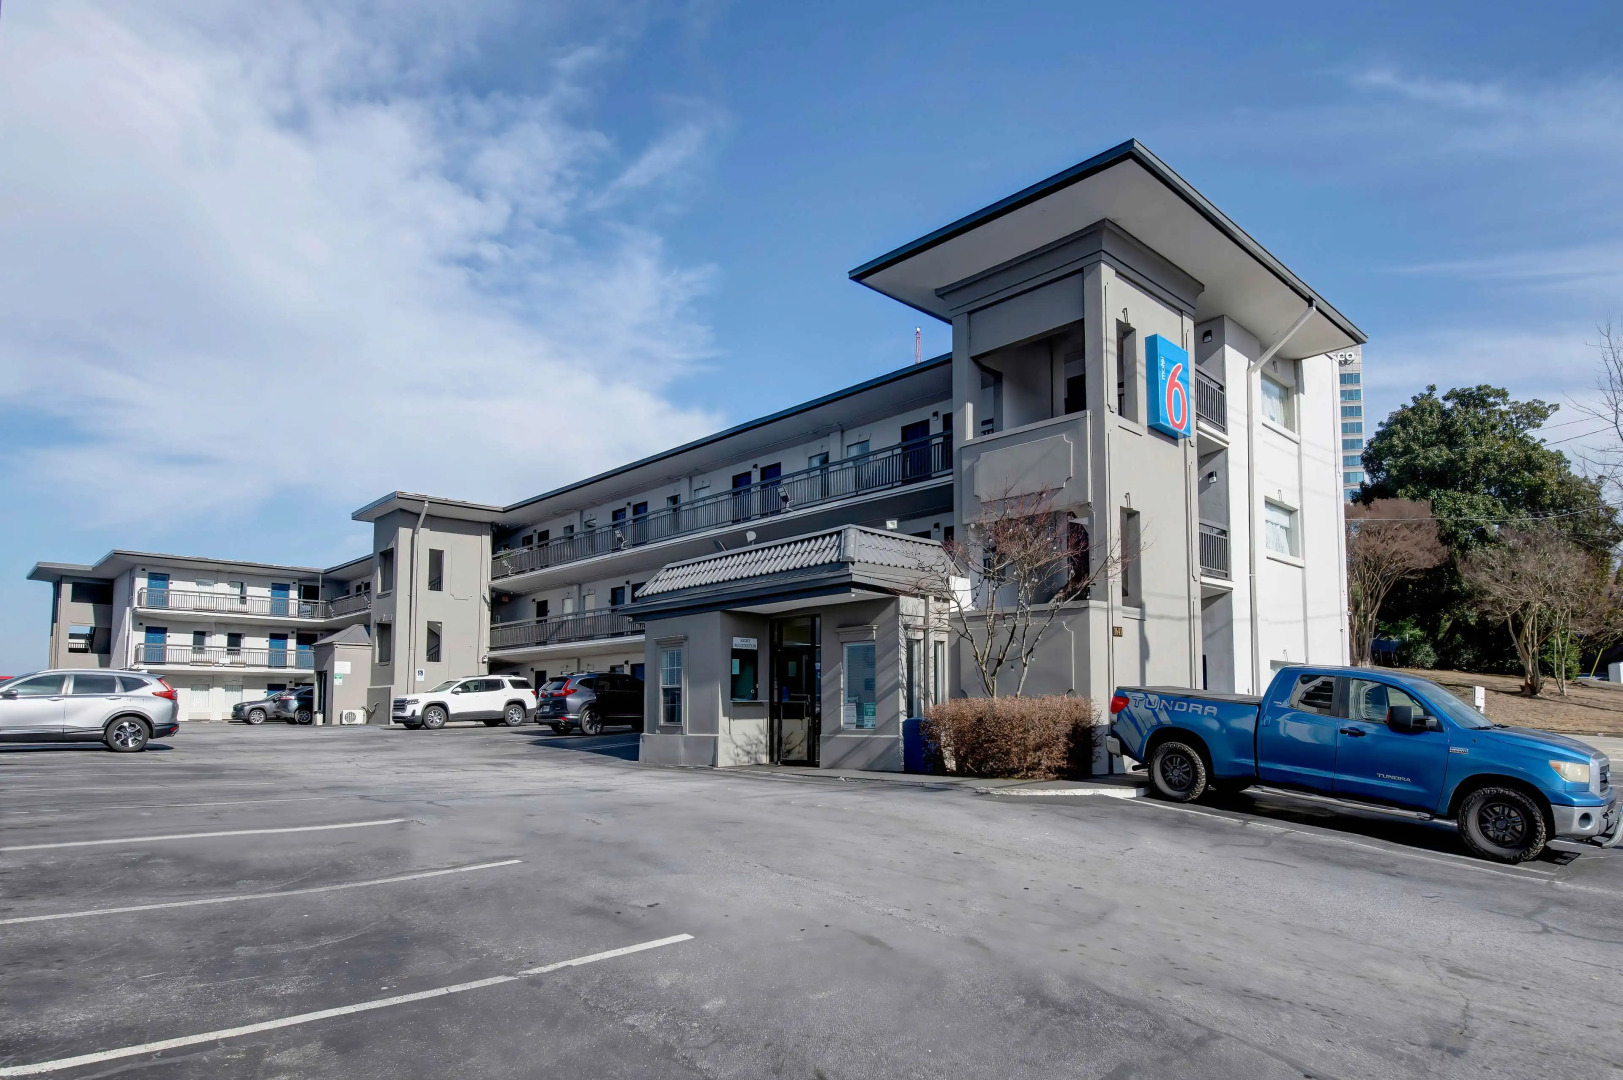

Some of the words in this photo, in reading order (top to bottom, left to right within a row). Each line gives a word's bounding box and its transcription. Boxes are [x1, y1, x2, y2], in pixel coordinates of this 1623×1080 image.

[1166, 363, 1187, 431] 6
[1131, 695, 1218, 717] TUNDRA
[1376, 772, 1412, 783] TUNDRA
